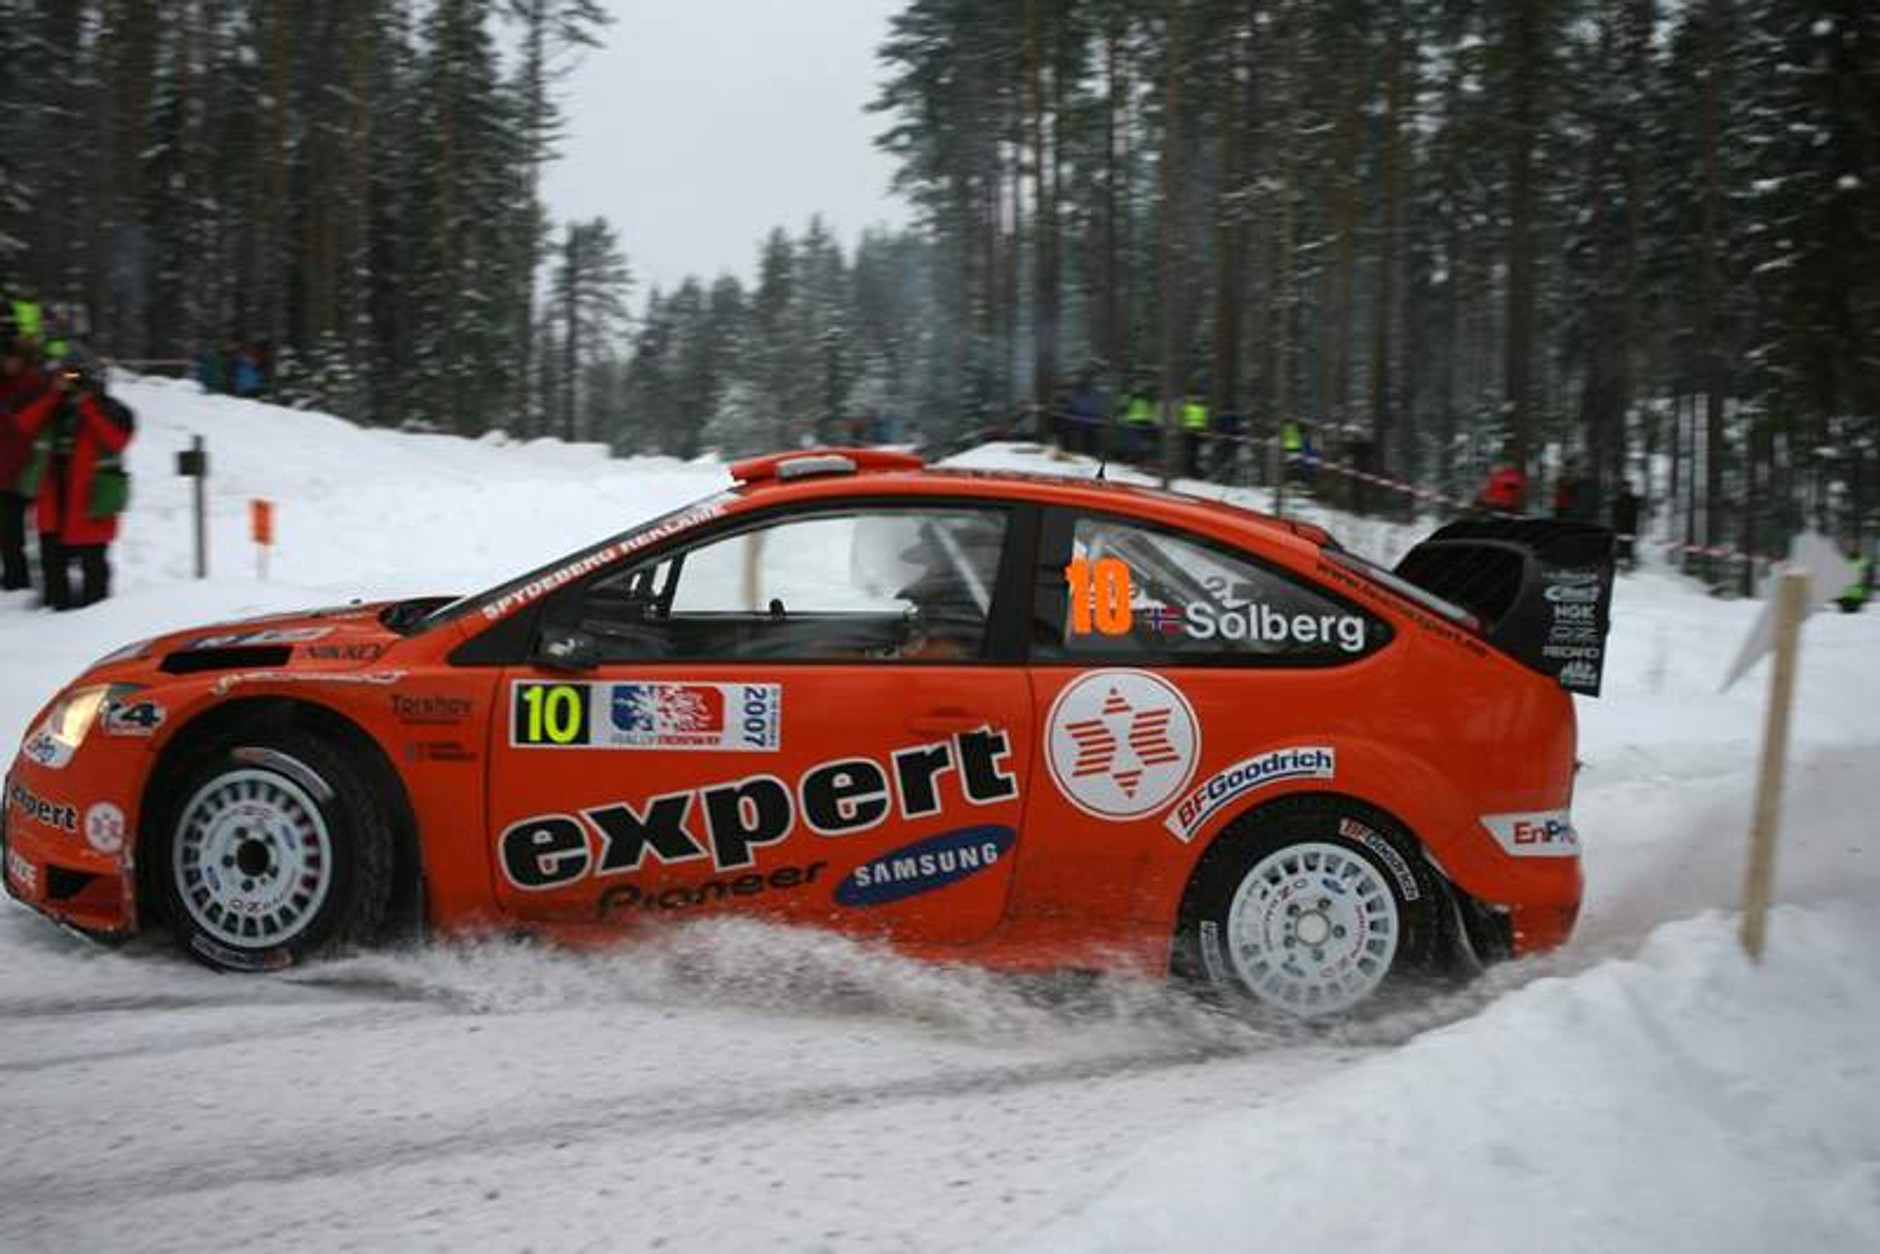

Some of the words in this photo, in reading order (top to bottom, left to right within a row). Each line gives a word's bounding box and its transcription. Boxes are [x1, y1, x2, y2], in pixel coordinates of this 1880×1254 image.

[481, 546, 616, 620] SPYDEBERG
[1065, 556, 1132, 635] 10
[1185, 601, 1365, 652] Solberg
[521, 684, 583, 743] 10
[743, 686, 768, 748] 2007
[500, 726, 1019, 890] expert
[1177, 750, 1332, 829] BFGoodrich
[600, 860, 829, 914] Pioneer
[853, 842, 999, 889] SAMSUNG
